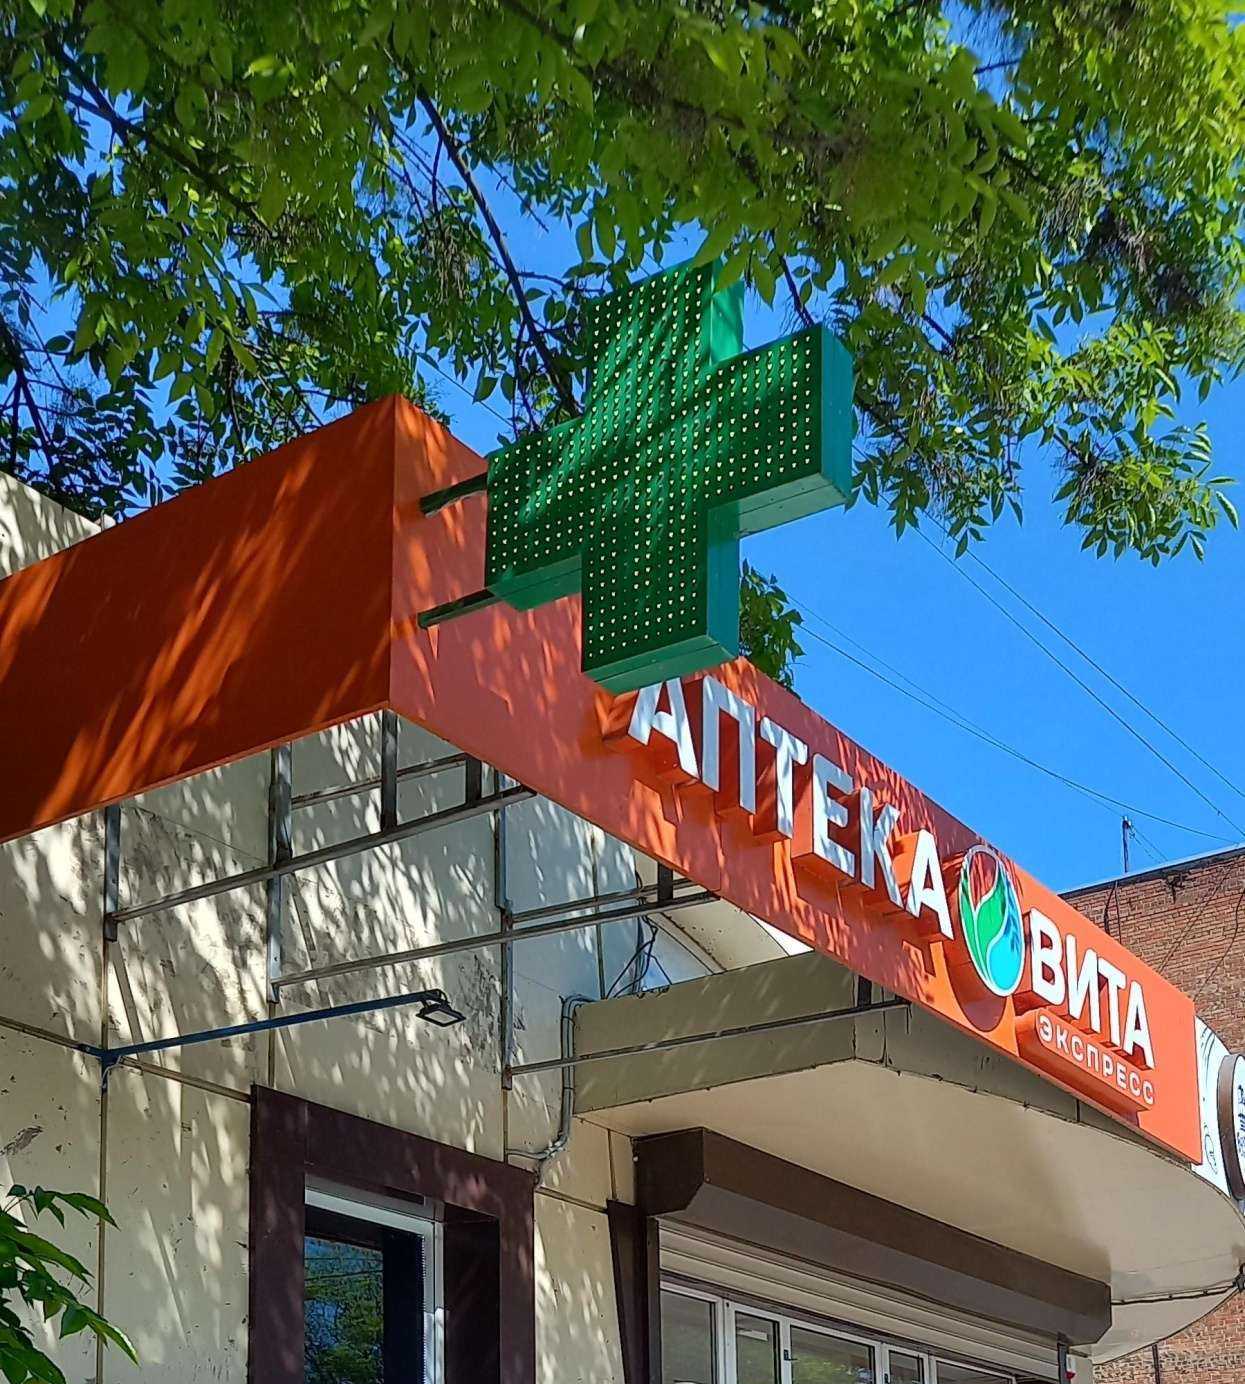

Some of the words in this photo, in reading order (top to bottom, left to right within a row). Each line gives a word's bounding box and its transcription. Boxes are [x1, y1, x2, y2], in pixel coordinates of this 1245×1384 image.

[628, 676, 954, 939] АПТЕКА
[1029, 907, 1156, 1069] ВИТА
[1039, 1014, 1155, 1106] ЭКСПРЕСС
